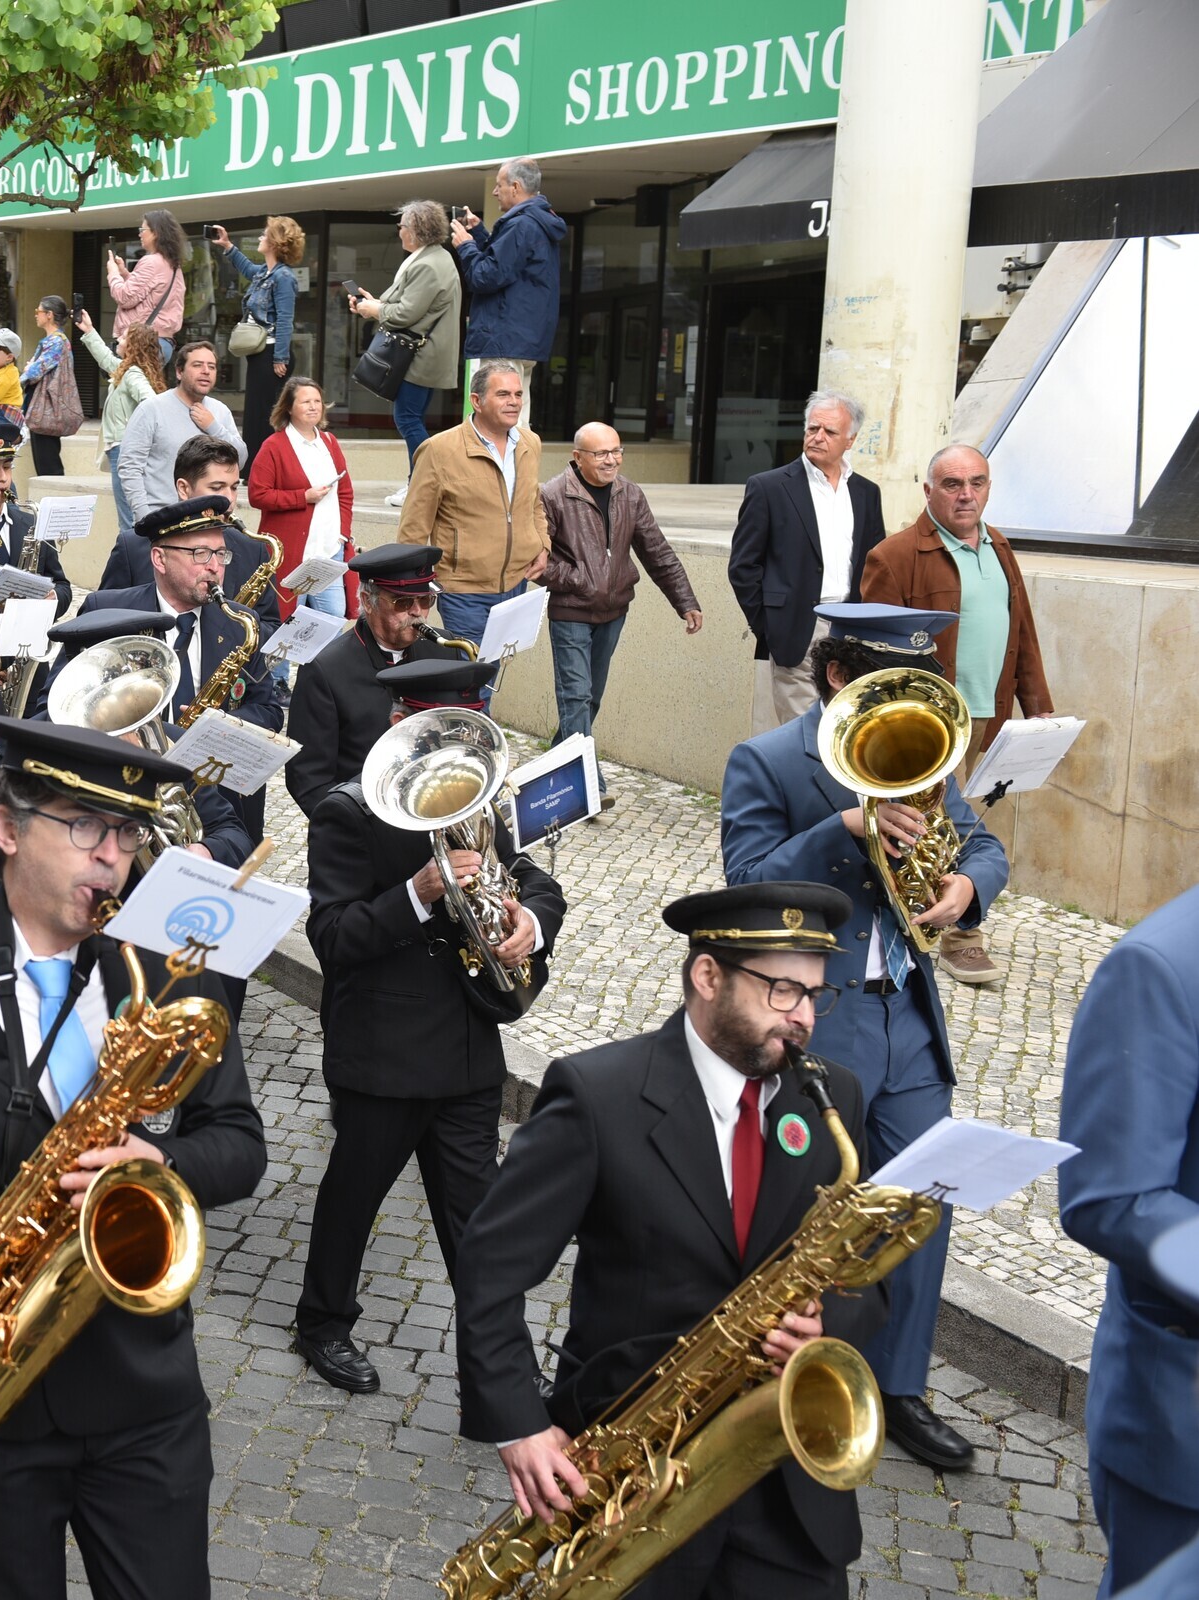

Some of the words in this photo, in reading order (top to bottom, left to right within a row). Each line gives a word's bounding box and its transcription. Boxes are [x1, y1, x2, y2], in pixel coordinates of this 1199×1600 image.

[225, 33, 521, 171] D.DINIS
[530, 798, 547, 809] Banda
[545, 797, 561, 810] SAMP
